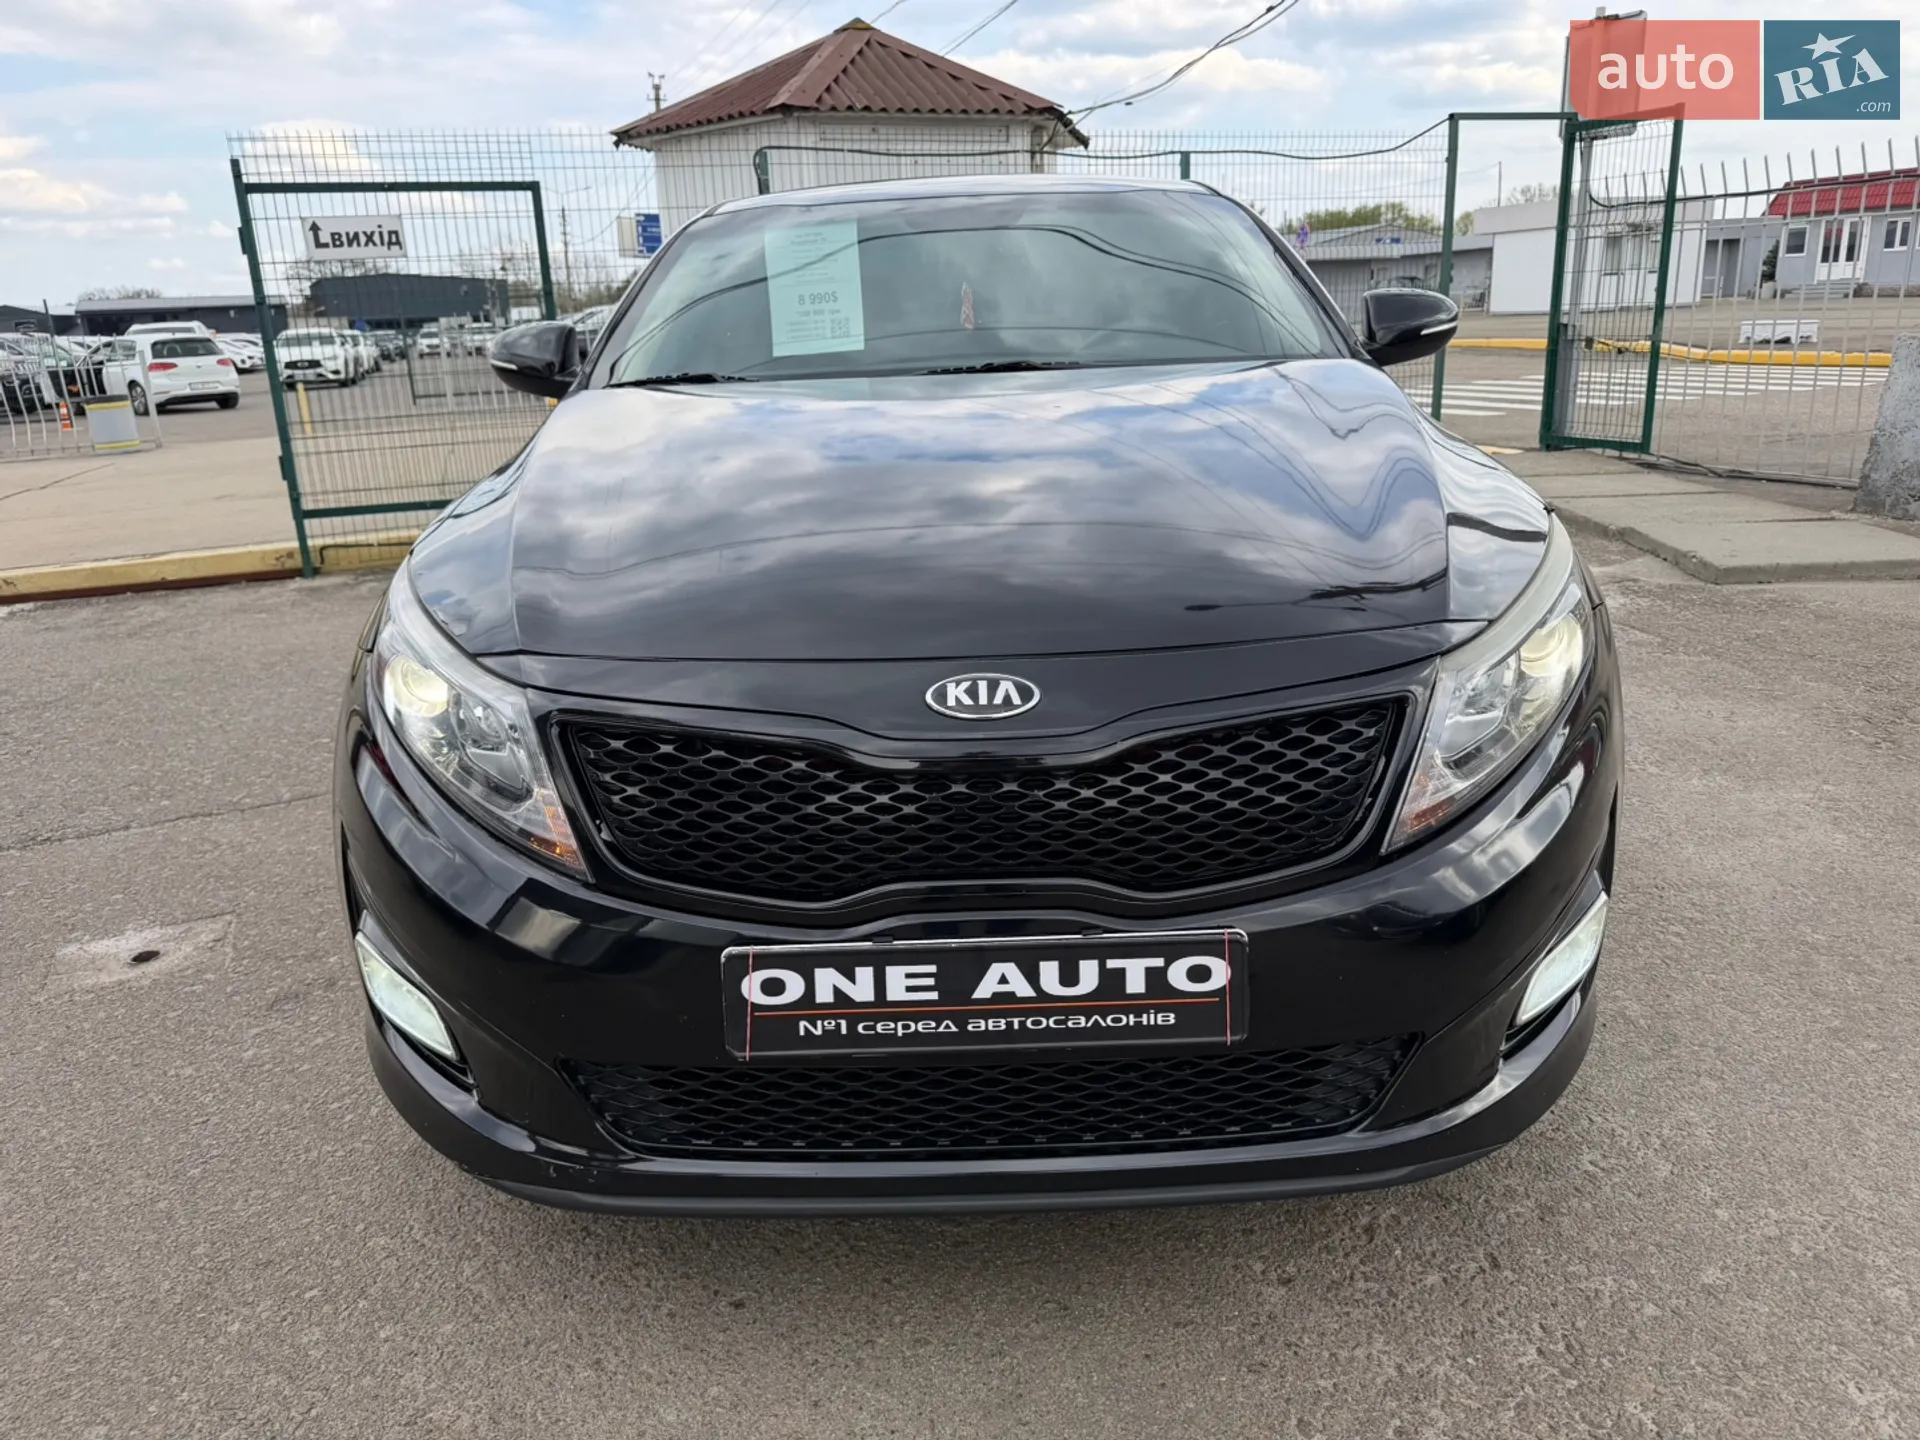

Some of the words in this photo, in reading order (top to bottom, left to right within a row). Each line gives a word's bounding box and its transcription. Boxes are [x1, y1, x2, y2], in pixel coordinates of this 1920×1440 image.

[329, 224, 403, 251] вихід
[945, 680, 1023, 707] KIA
[740, 964, 940, 1006] ONE
[971, 955, 1232, 1000] AUTO
[857, 1018, 960, 1038] серед
[966, 1009, 1177, 1033] автосалонів
